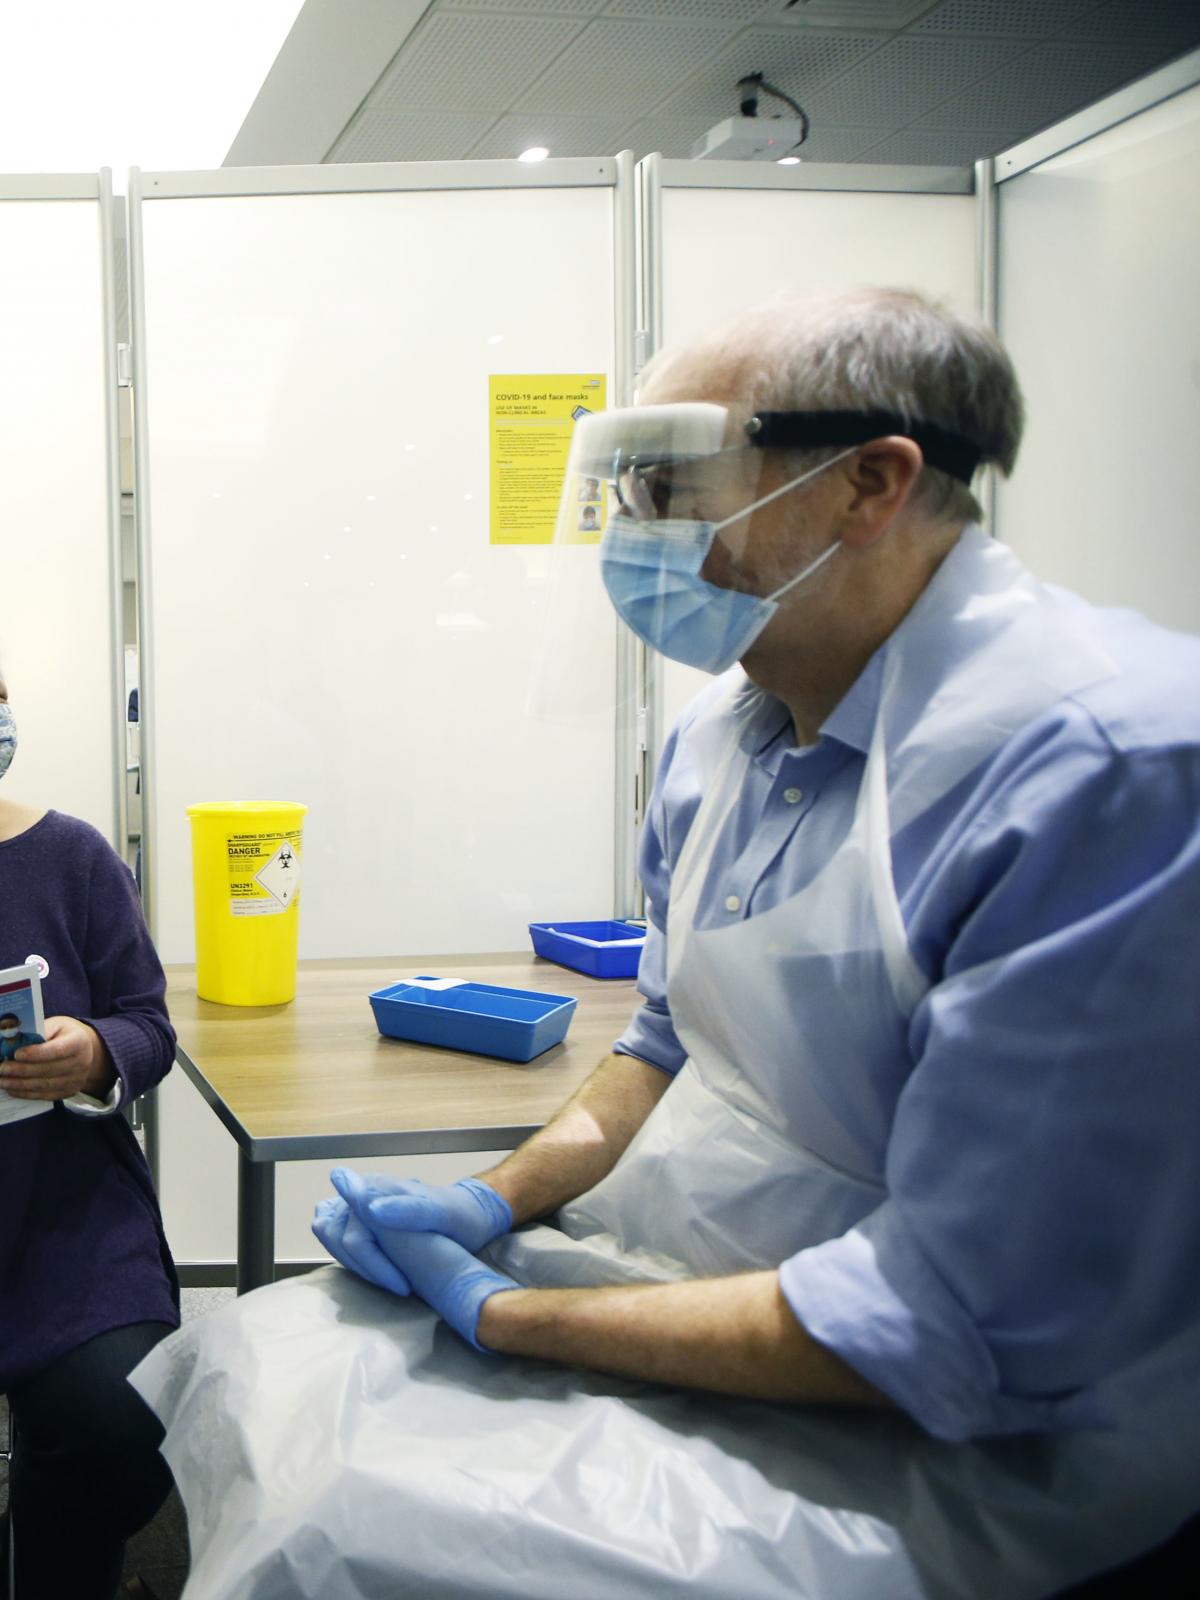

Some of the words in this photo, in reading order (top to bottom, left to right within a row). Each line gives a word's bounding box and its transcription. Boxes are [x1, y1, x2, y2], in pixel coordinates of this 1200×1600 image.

[496, 393, 531, 401] COVID-19
[533, 393, 547, 401] and
[548, 393, 563, 401] face
[566, 393, 588, 401] masks
